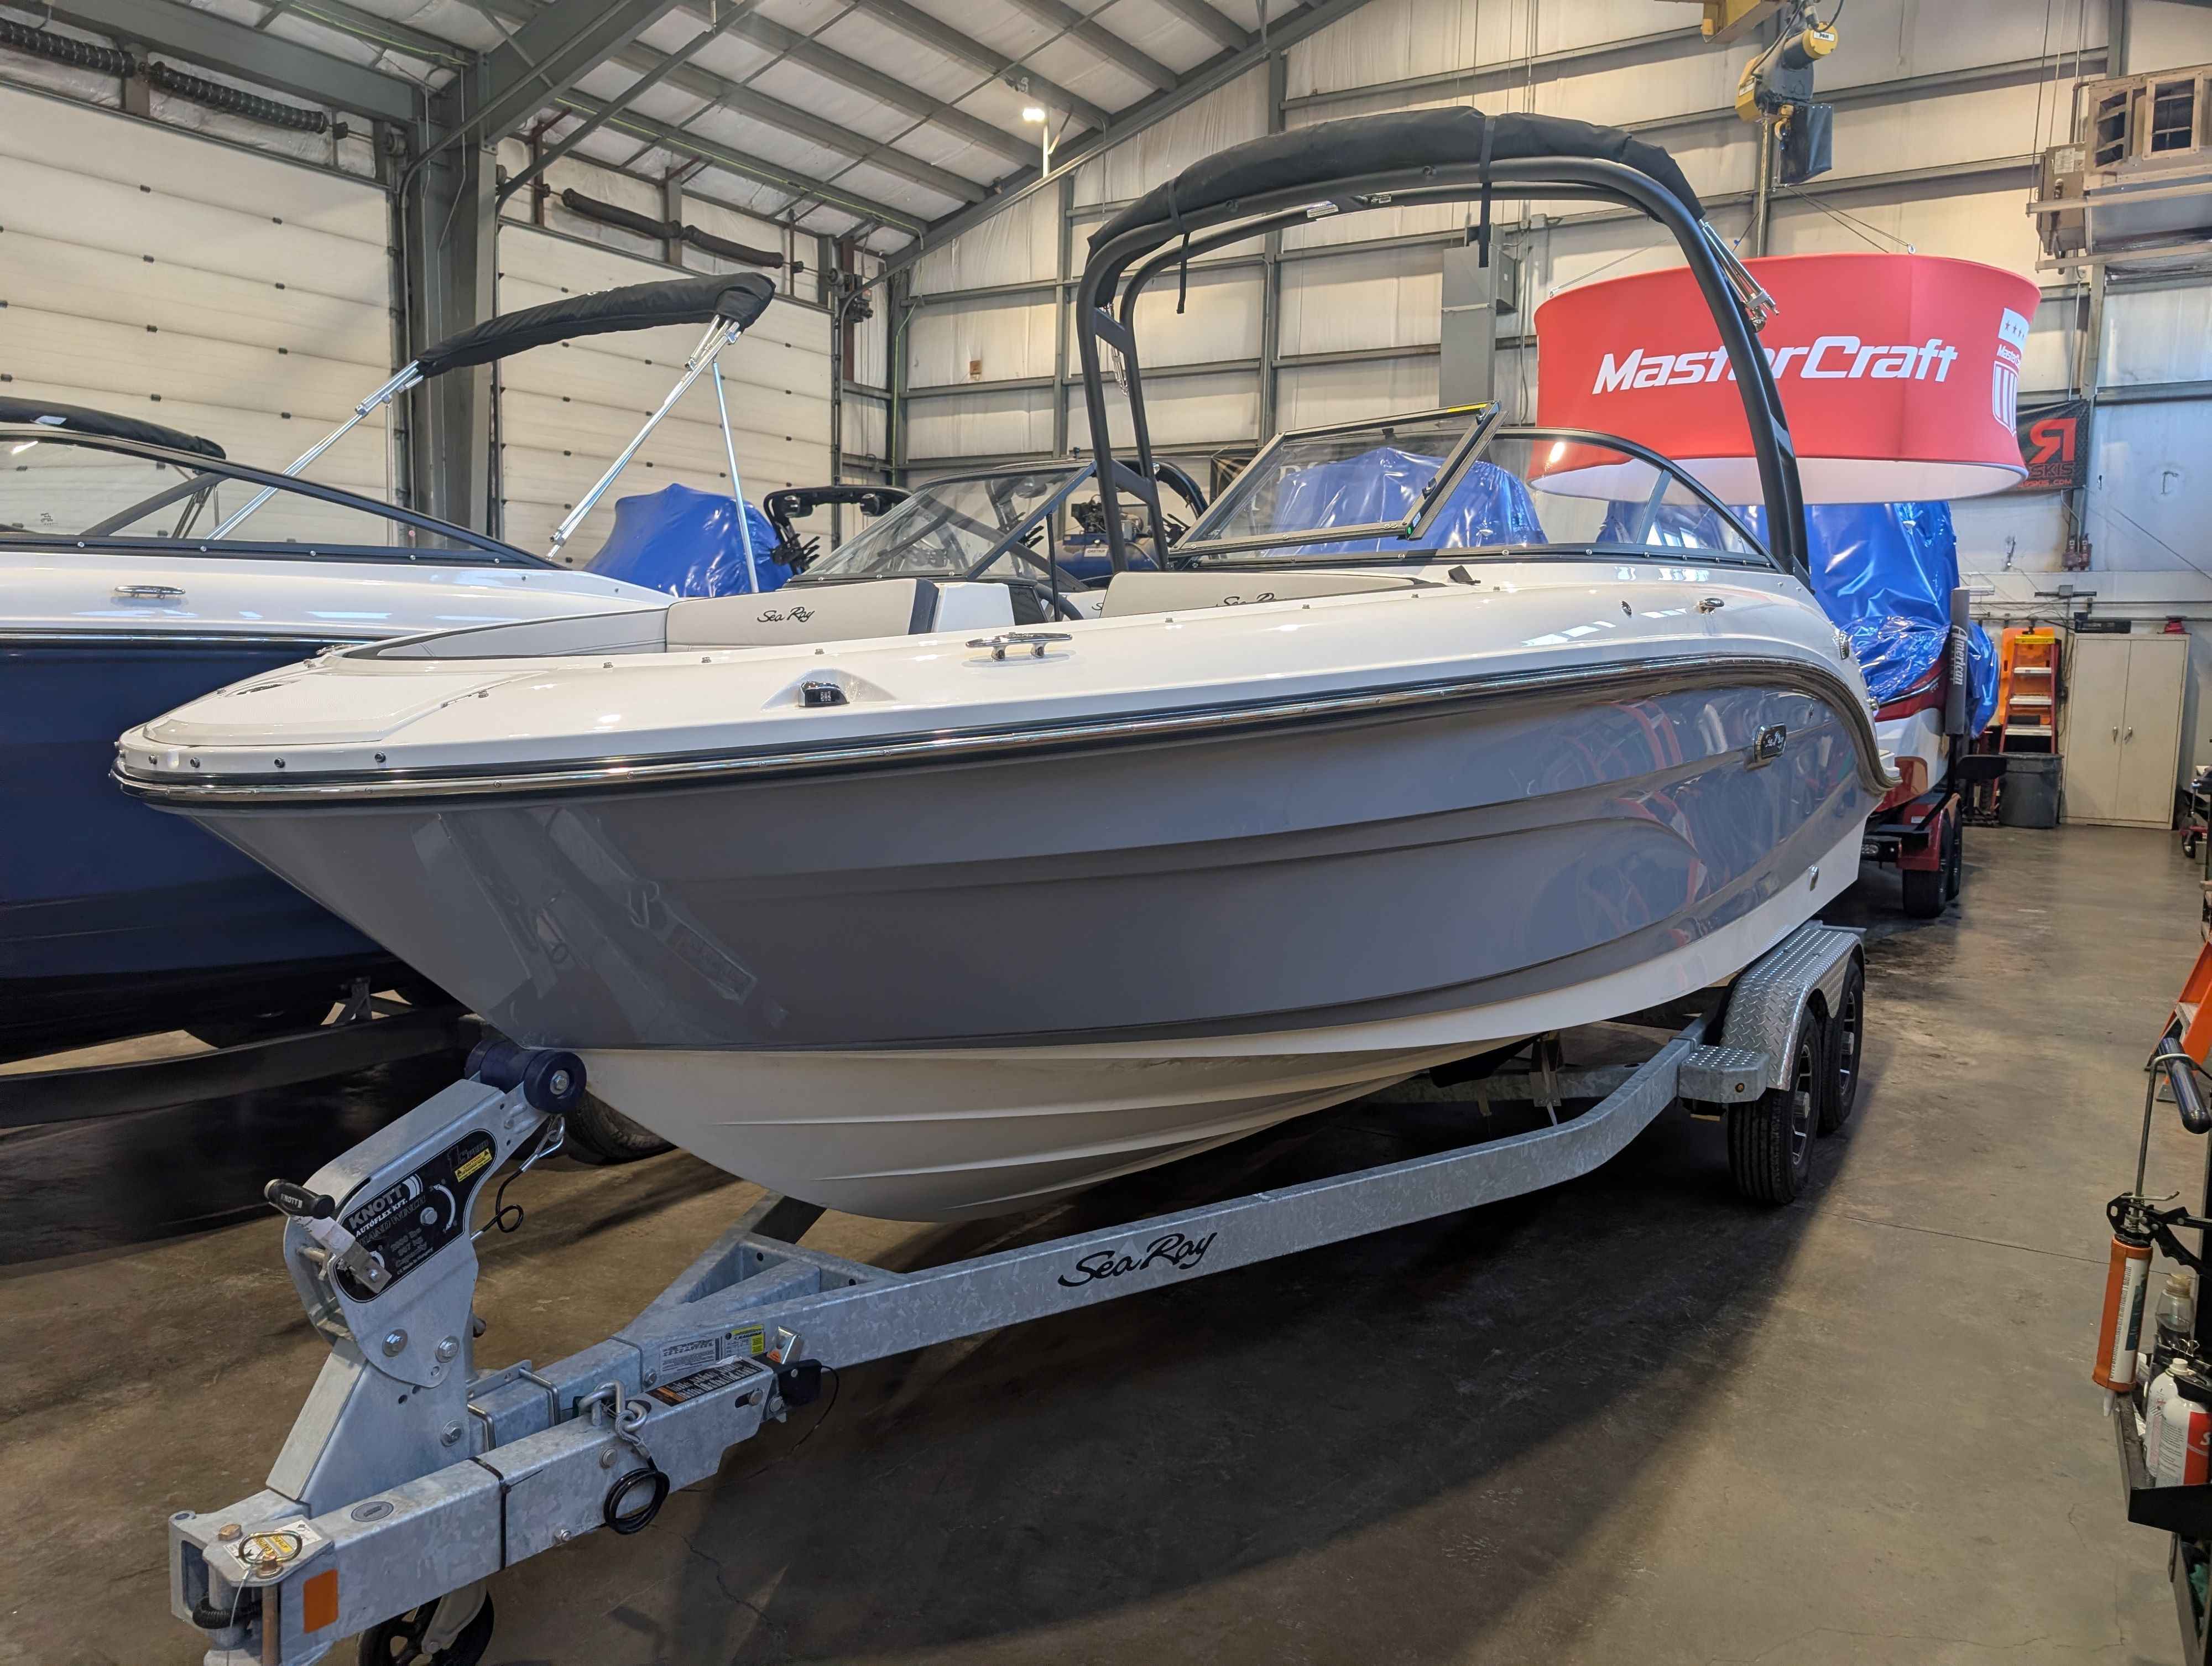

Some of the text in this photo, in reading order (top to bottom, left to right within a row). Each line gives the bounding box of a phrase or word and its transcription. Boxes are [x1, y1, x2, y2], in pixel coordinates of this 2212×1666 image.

[1592, 336, 1958, 395] MastrCraft
[757, 606, 816, 623] Sea Ray
[348, 1183, 404, 1230] KNOTT
[356, 1198, 408, 1237] AUTÓFLEX KFT.
[1057, 1232, 1218, 1287] Sea Ray
